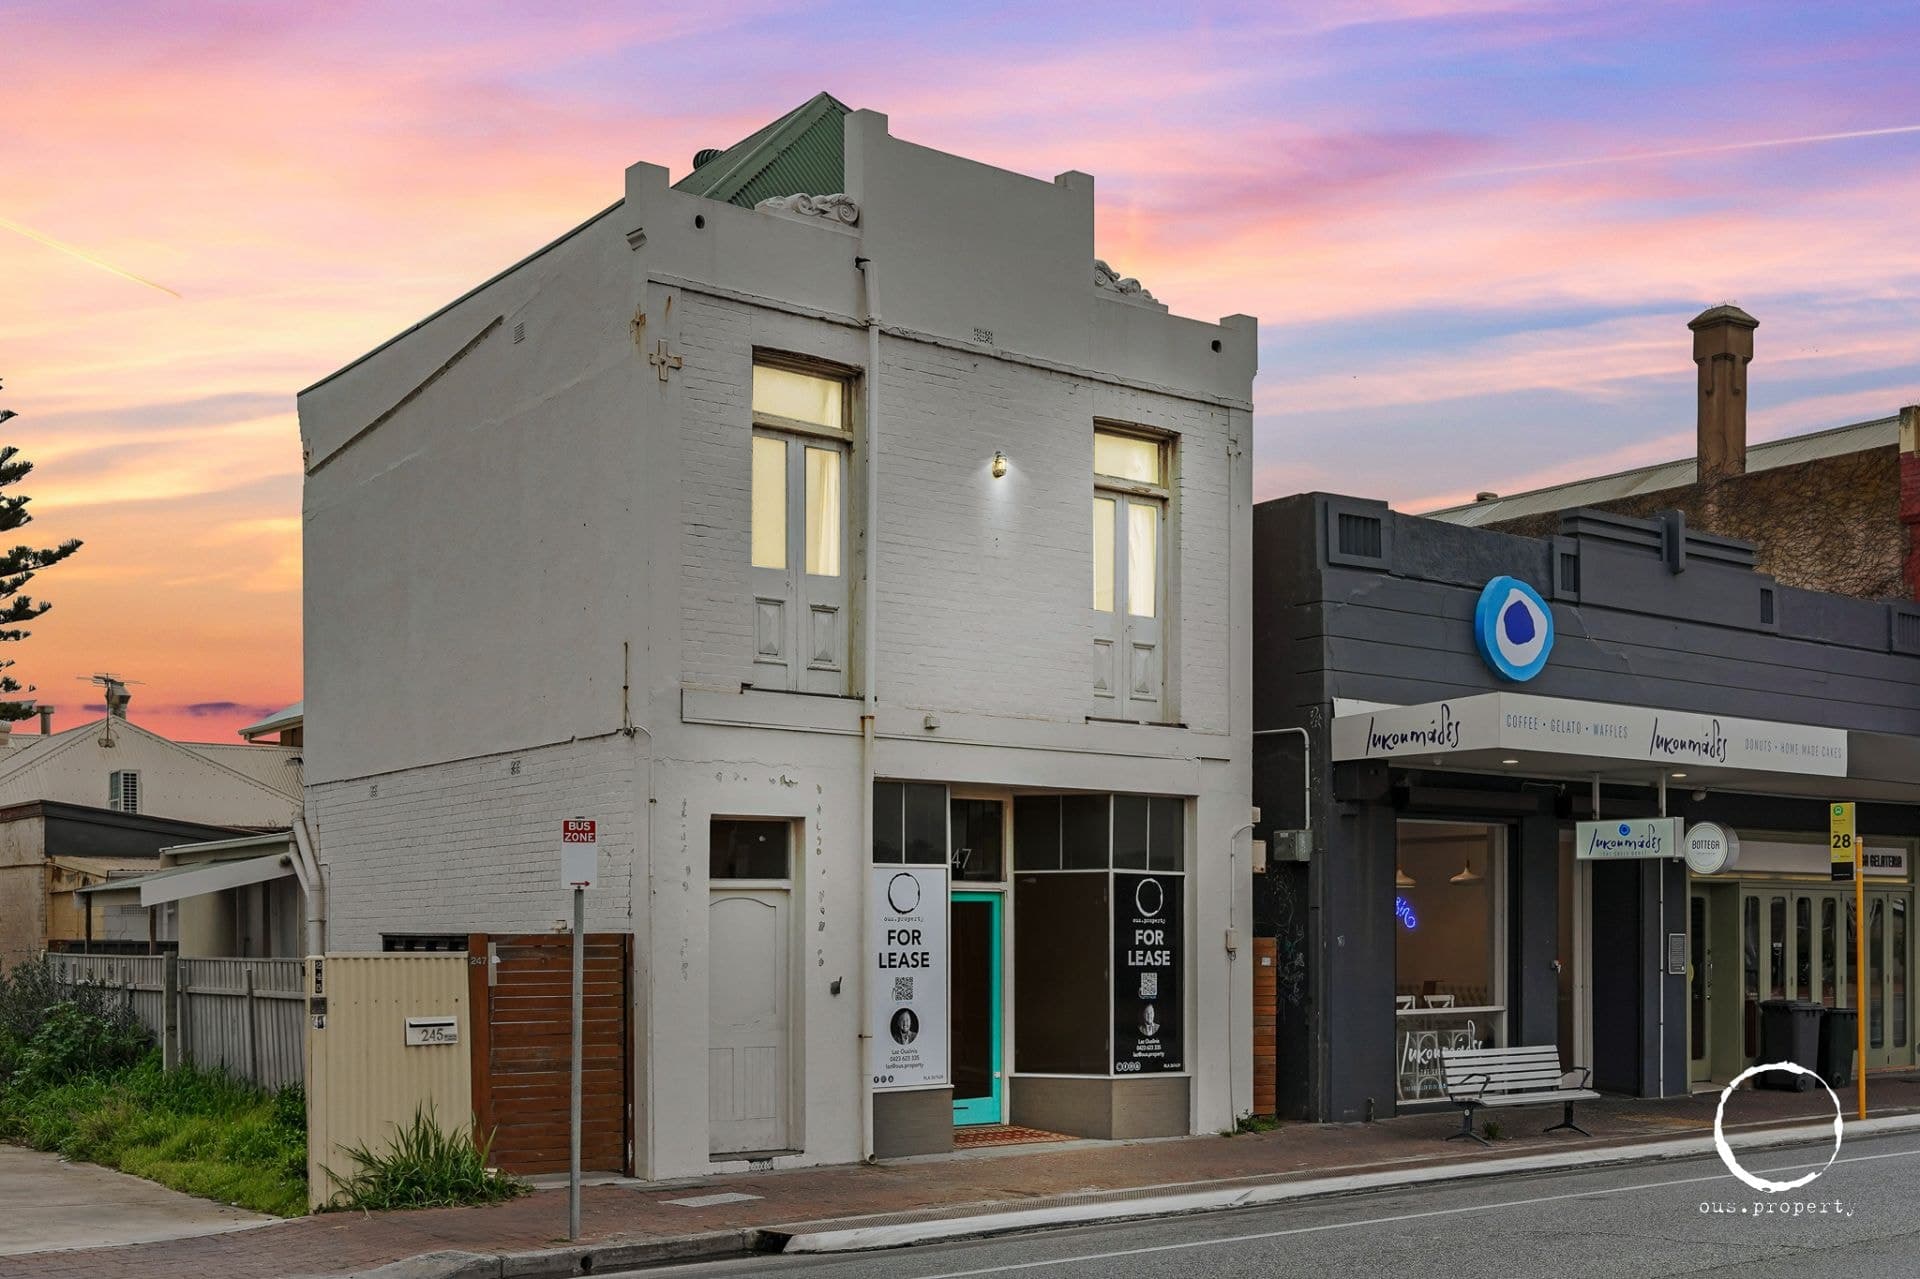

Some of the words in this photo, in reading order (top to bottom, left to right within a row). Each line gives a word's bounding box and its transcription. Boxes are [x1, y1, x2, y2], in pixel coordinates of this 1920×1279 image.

[1506, 714, 1538, 730] COFFEE
[1550, 719, 1582, 735] GELATO
[1593, 724, 1628, 739] WAFFLES
[1744, 738, 1772, 753] DONUTS
[1781, 742, 1799, 756] HOME
[1802, 744, 1819, 757] MADE
[1821, 746, 1842, 759] CAKES
[568, 821, 591, 831] BUS
[564, 832, 595, 842] ZONE
[1691, 839, 1720, 850] BOTTEGA
[1832, 834, 1852, 849] 28
[887, 929, 922, 946] FOR
[1135, 929, 1164, 946] FOR
[471, 956, 487, 965] 247
[878, 951, 930, 969] LEASE
[1127, 950, 1171, 966] LEASE
[421, 1028, 444, 1042] 245
